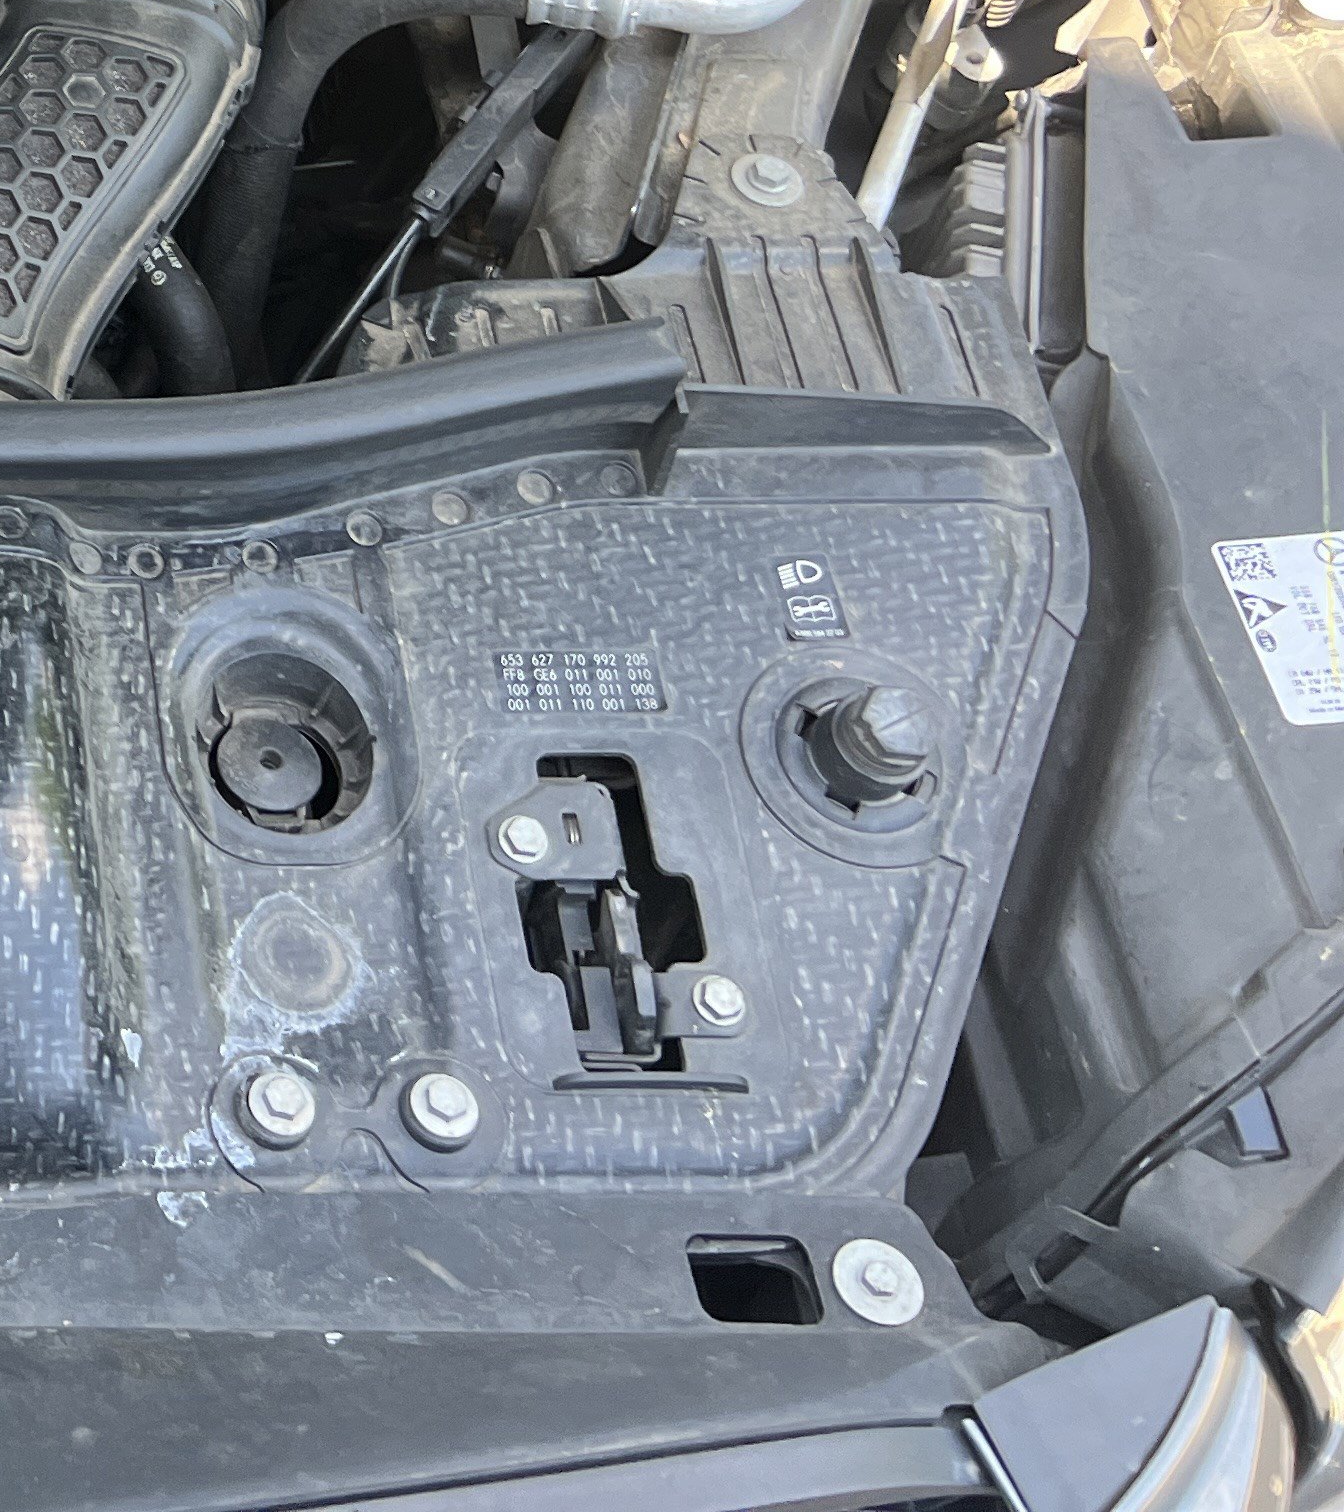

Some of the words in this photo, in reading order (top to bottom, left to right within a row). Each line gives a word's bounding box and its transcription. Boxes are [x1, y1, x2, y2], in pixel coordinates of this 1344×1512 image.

[501, 654, 523, 666] 653
[532, 654, 553, 666] 627
[564, 654, 585, 666] 170
[594, 654, 616, 666] 992
[625, 654, 648, 666] 205
[534, 669, 557, 681] GE6
[565, 669, 588, 681] 011
[596, 669, 618, 680] 001
[628, 669, 651, 680] 010
[507, 684, 528, 696] 100
[537, 684, 559, 696] 001
[570, 684, 591, 695] 100
[599, 684, 621, 695] 011
[631, 684, 654, 695] 000
[508, 699, 530, 710] 001
[540, 699, 561, 710] 011
[573, 699, 594, 710] 110
[603, 699, 624, 710] 001
[636, 698, 658, 709] 138
